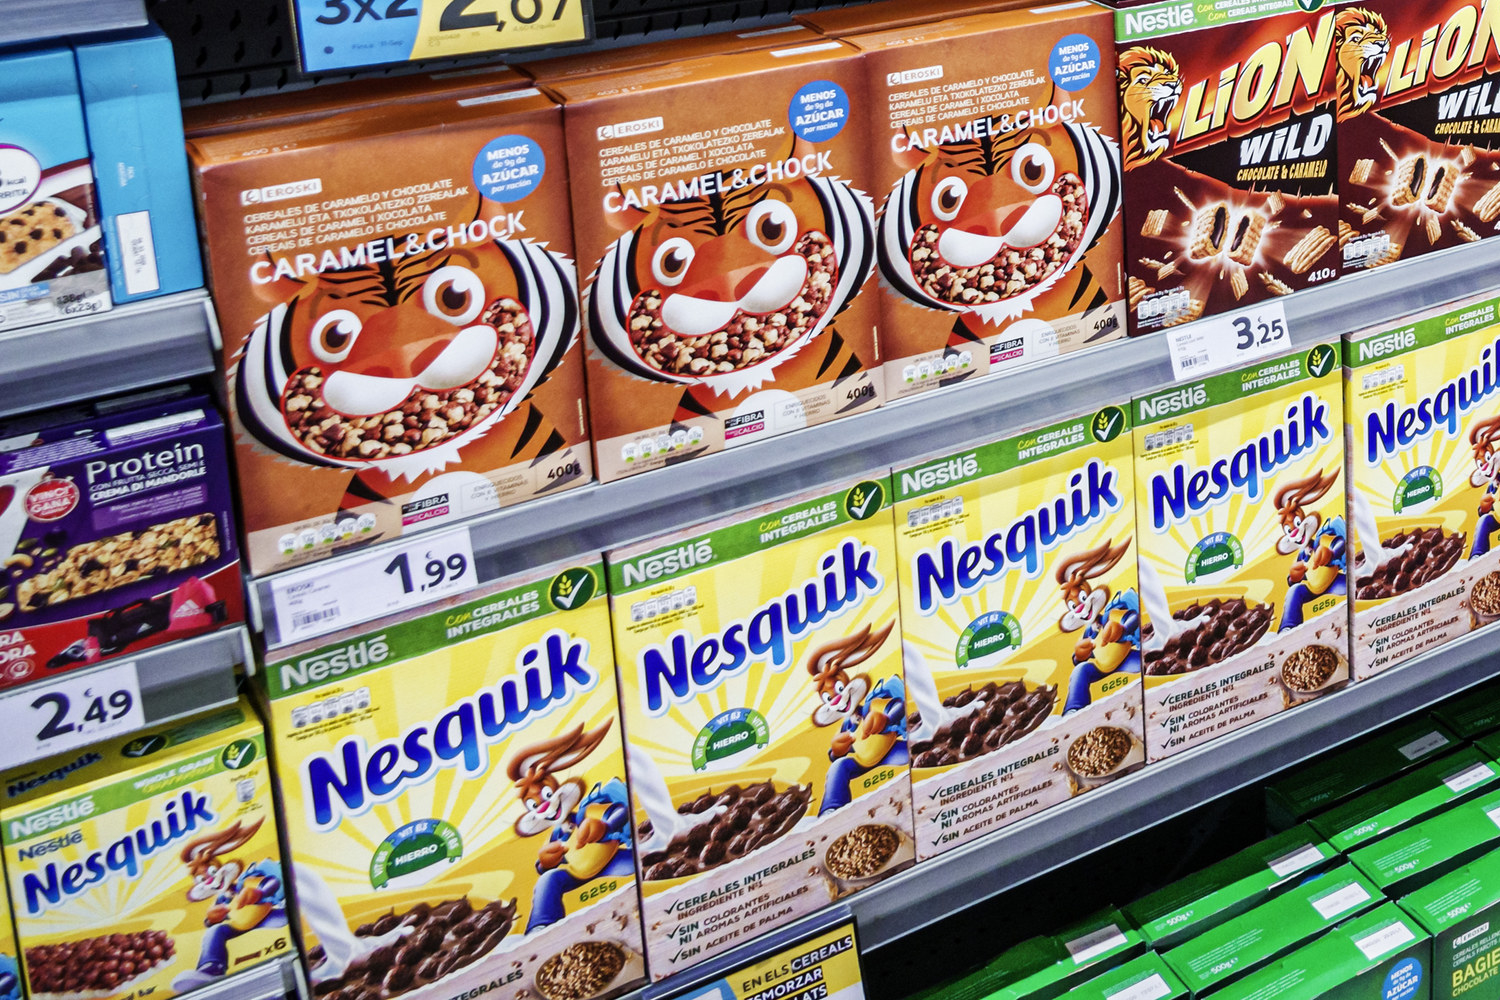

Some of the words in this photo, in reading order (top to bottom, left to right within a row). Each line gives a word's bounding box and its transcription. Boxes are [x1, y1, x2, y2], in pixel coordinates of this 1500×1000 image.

[488, 144, 530, 161] MENOS
[266, 182, 316, 198] EROSKI
[482, 164, 538, 185] AZÚCAR
[1308, 267, 1336, 283] 410g
[1233, 318, 1284, 351] 3,25
[87, 443, 203, 484] Protein
[1153, 396, 1329, 529] Nesquik
[916, 462, 1118, 611] Nesquik
[385, 552, 468, 595] 1,99
[644, 541, 878, 711] Nesquik
[1101, 675, 1129, 693] 625g
[1169, 682, 1217, 704] CEREALES
[1220, 661, 1275, 687] INTEGRALES
[1169, 691, 1220, 712] INGREDIENTE
[30, 691, 132, 740] 2,49
[308, 634, 591, 826] Nesquik
[1169, 716, 1185, 726] SIN
[1189, 696, 1239, 719] COLORANTES
[1170, 726, 1180, 734] NI
[1182, 713, 1216, 730] AROMAS
[1219, 692, 1268, 717] ARTIFICIALES
[1170, 736, 1186, 747] SIN
[1189, 726, 1215, 740] ACEITE
[1229, 709, 1255, 725] PALMA
[23, 790, 214, 915] Nesquik
[743, 976, 762, 992] EN
[764, 967, 789, 983] ELS
[791, 936, 853, 971] CEREALS
